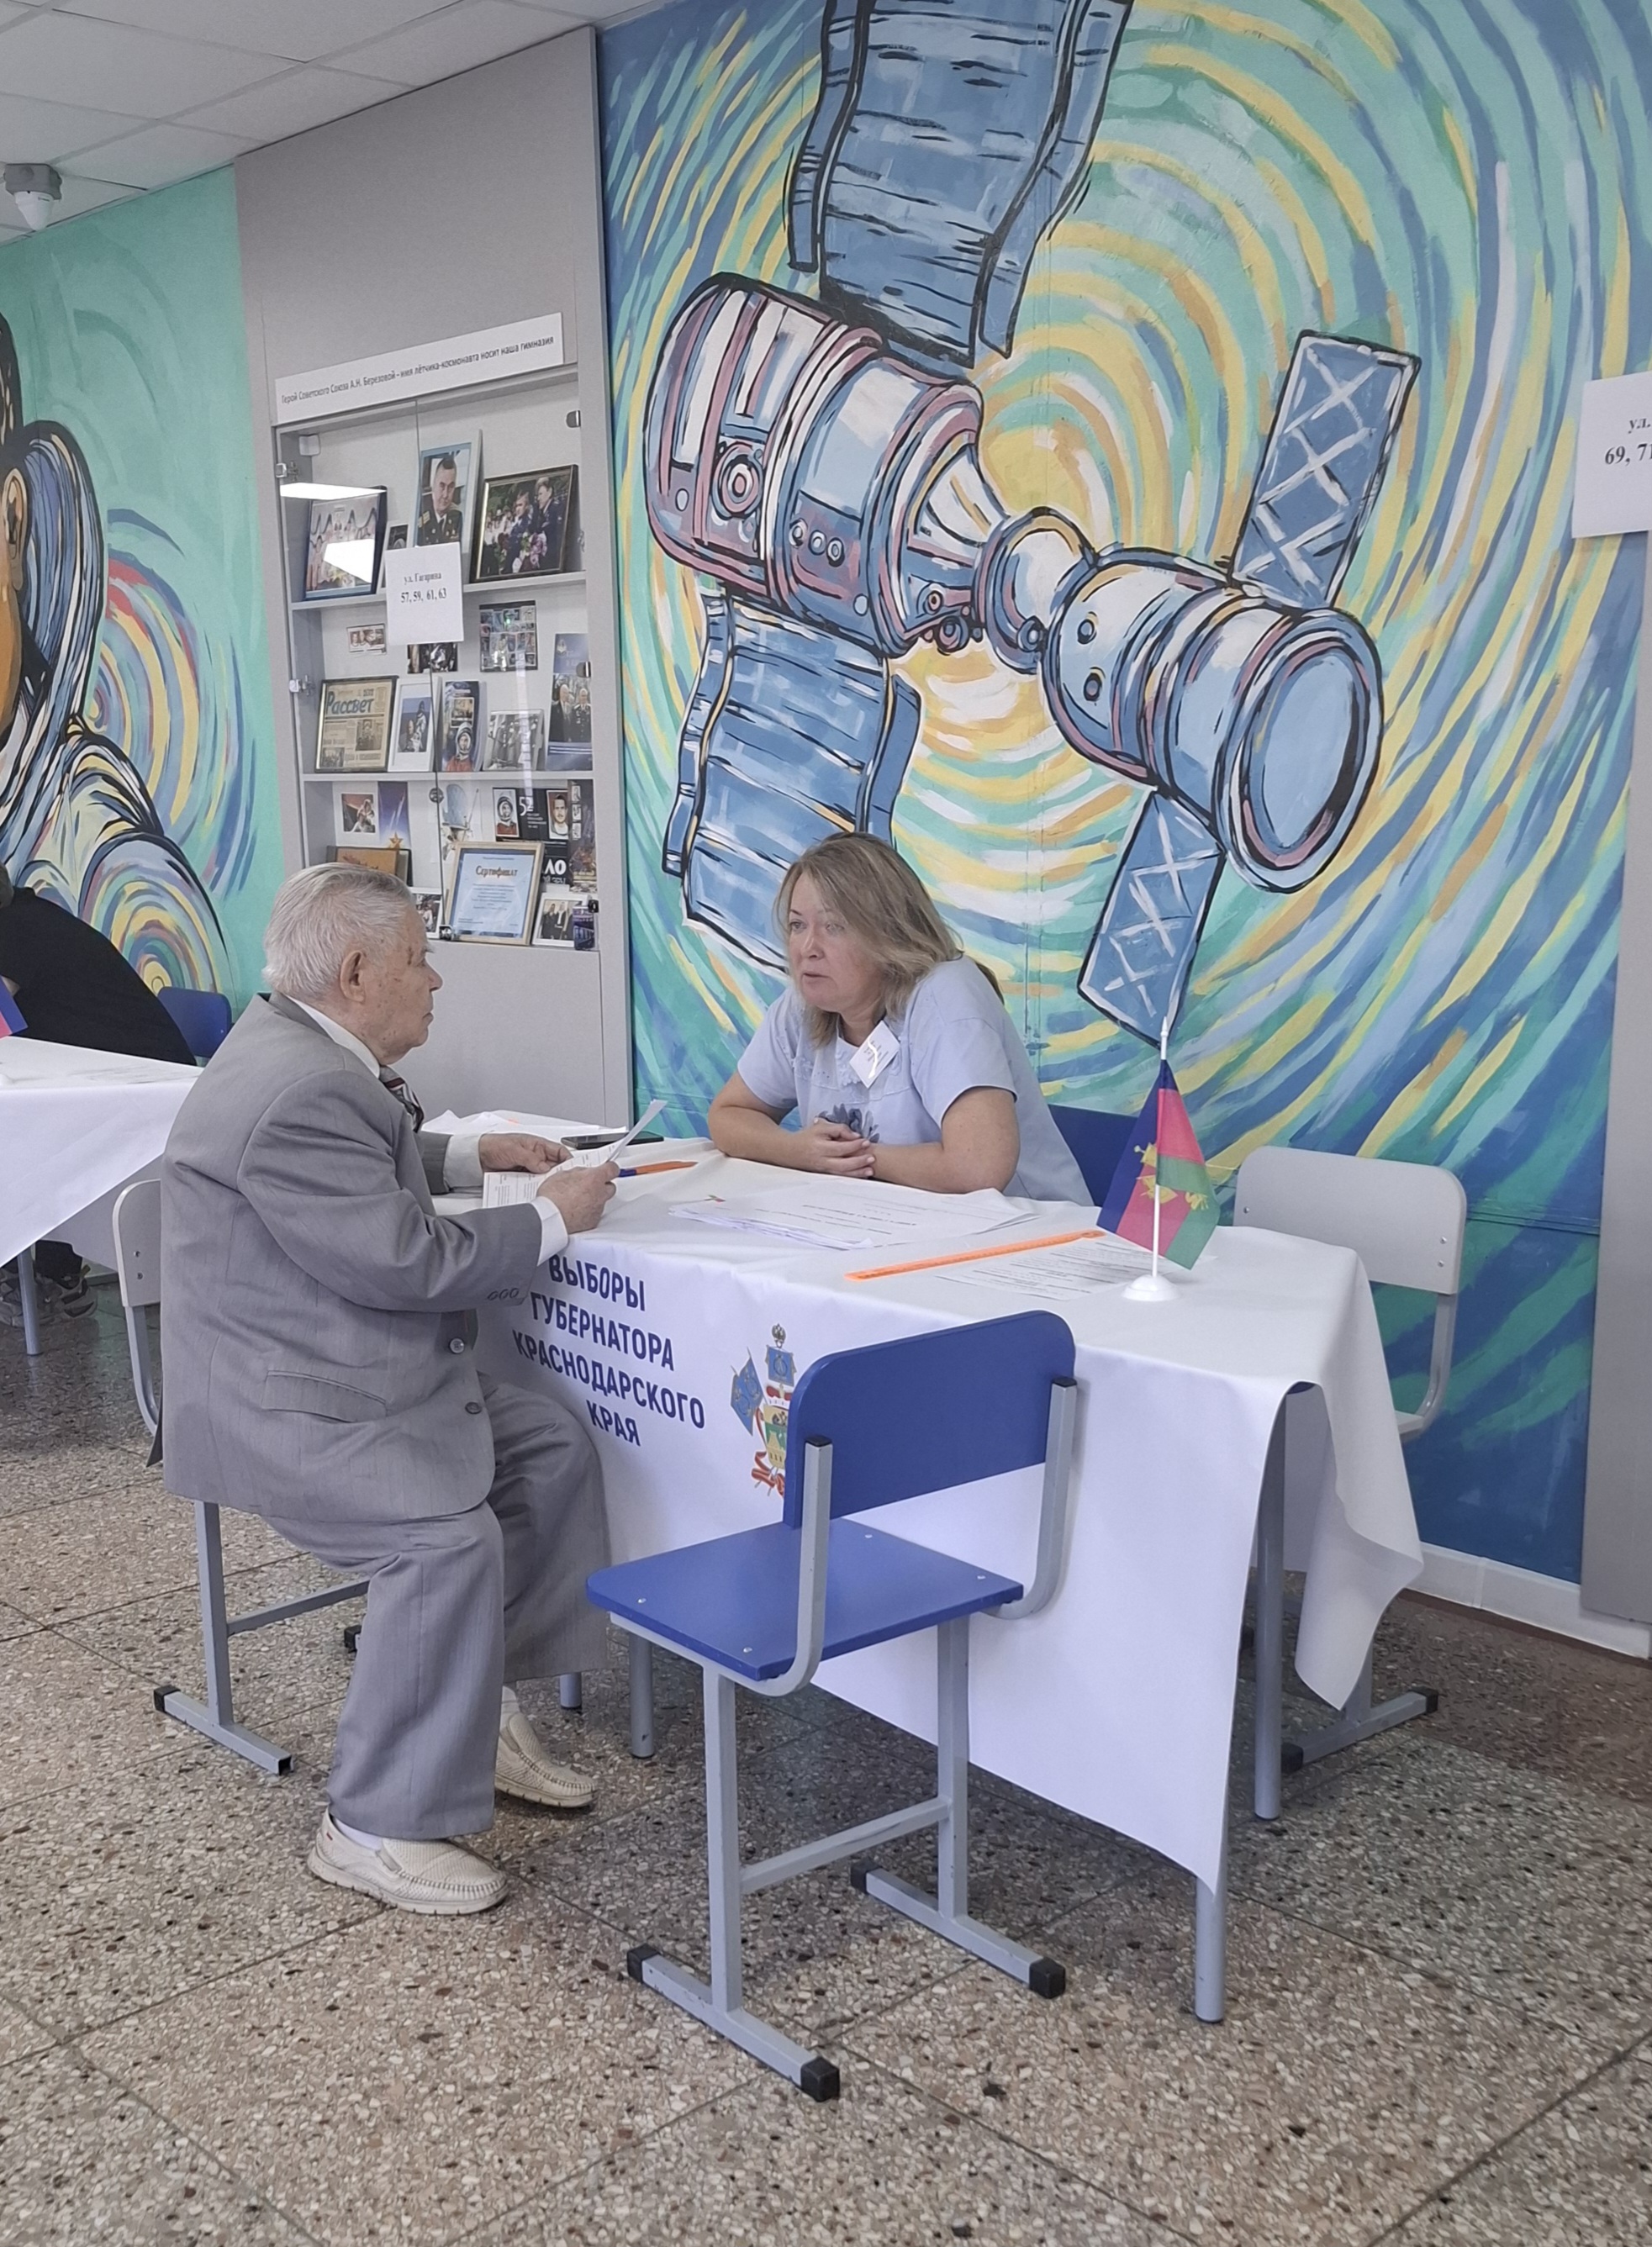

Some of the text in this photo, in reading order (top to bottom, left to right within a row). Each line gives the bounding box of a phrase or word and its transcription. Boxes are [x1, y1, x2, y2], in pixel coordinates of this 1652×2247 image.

[282, 393, 298, 404] Герой
[298, 387, 330, 400] Советского
[330, 382, 349, 393] Союза
[350, 379, 362, 389] А.Н.
[363, 371, 396, 386] Березовой
[400, 368, 413, 377] имя
[414, 353, 479, 376] лётчика-космонавта
[481, 348, 499, 361] носит
[501, 344, 519, 356] наша
[520, 336, 554, 351] гимназия
[1628, 418, 1651, 434] ул.
[1605, 446, 1631, 467] 69,
[401, 588, 446, 603] 57, 59, 61, 63
[325, 691, 375, 715] Рассвет
[548, 1253, 646, 1312] ВЫБОРЫ
[530, 1291, 675, 1372] ГУБЕРНАТОРА
[512, 1329, 705, 1430] КРАСНОДАРСКОГО
[585, 1399, 641, 1447] КРАЯ
